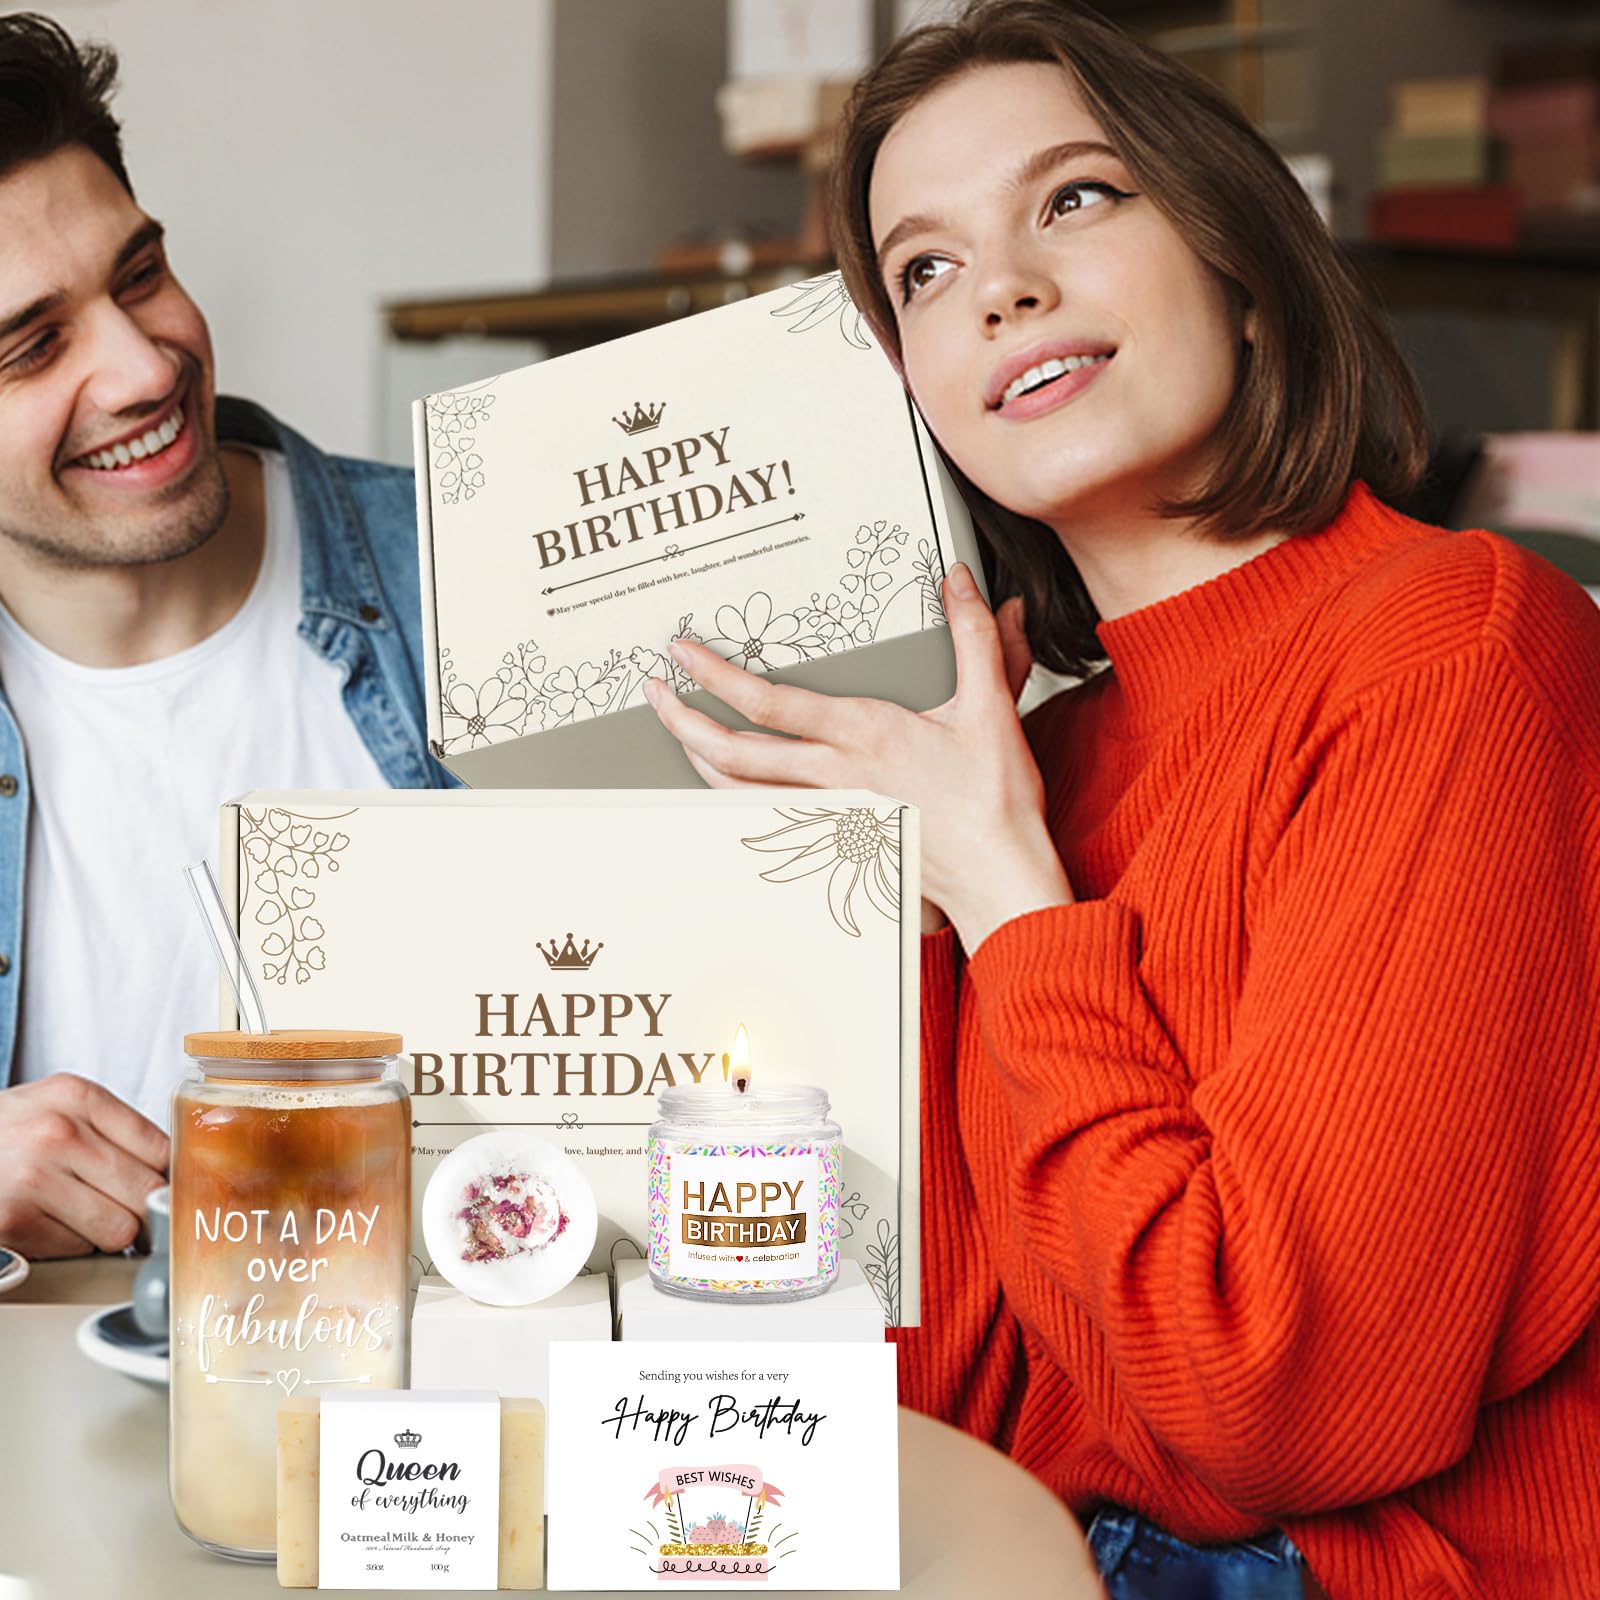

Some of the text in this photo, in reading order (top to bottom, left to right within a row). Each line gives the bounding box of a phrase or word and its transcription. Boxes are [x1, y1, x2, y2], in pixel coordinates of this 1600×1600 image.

[573, 426, 731, 506] HAPPY
[532, 459, 795, 569] BIRTHDAY!
[556, 535, 811, 615] May your special day be filled with love, laughter, and wonderful memories.
[475, 993, 672, 1037] HAPPY
[418, 1146, 435, 1156] May
[437, 1148, 453, 1156] you
[564, 1146, 584, 1156] love,
[586, 1146, 624, 1156] laughter,
[626, 1146, 642, 1155] and
[683, 1180, 804, 1213] HAPPY
[195, 1205, 380, 1246] NOT A DAY
[687, 1219, 800, 1243] BIRTHDAY
[247, 1257, 329, 1282] over
[687, 1251, 717, 1261] Infused
[718, 1254, 736, 1262] with
[753, 1251, 800, 1262] celebration
[198, 1293, 392, 1372] fabulous
[639, 1369, 789, 1383] Sending you wishes for a very
[601, 1394, 827, 1446] Happy Birthday
[356, 1449, 462, 1487] Queen
[675, 1470, 756, 1489] BEST WISHES
[351, 1487, 471, 1514] of everything
[340, 1531, 475, 1545] Oatmeal Milk & Honey
